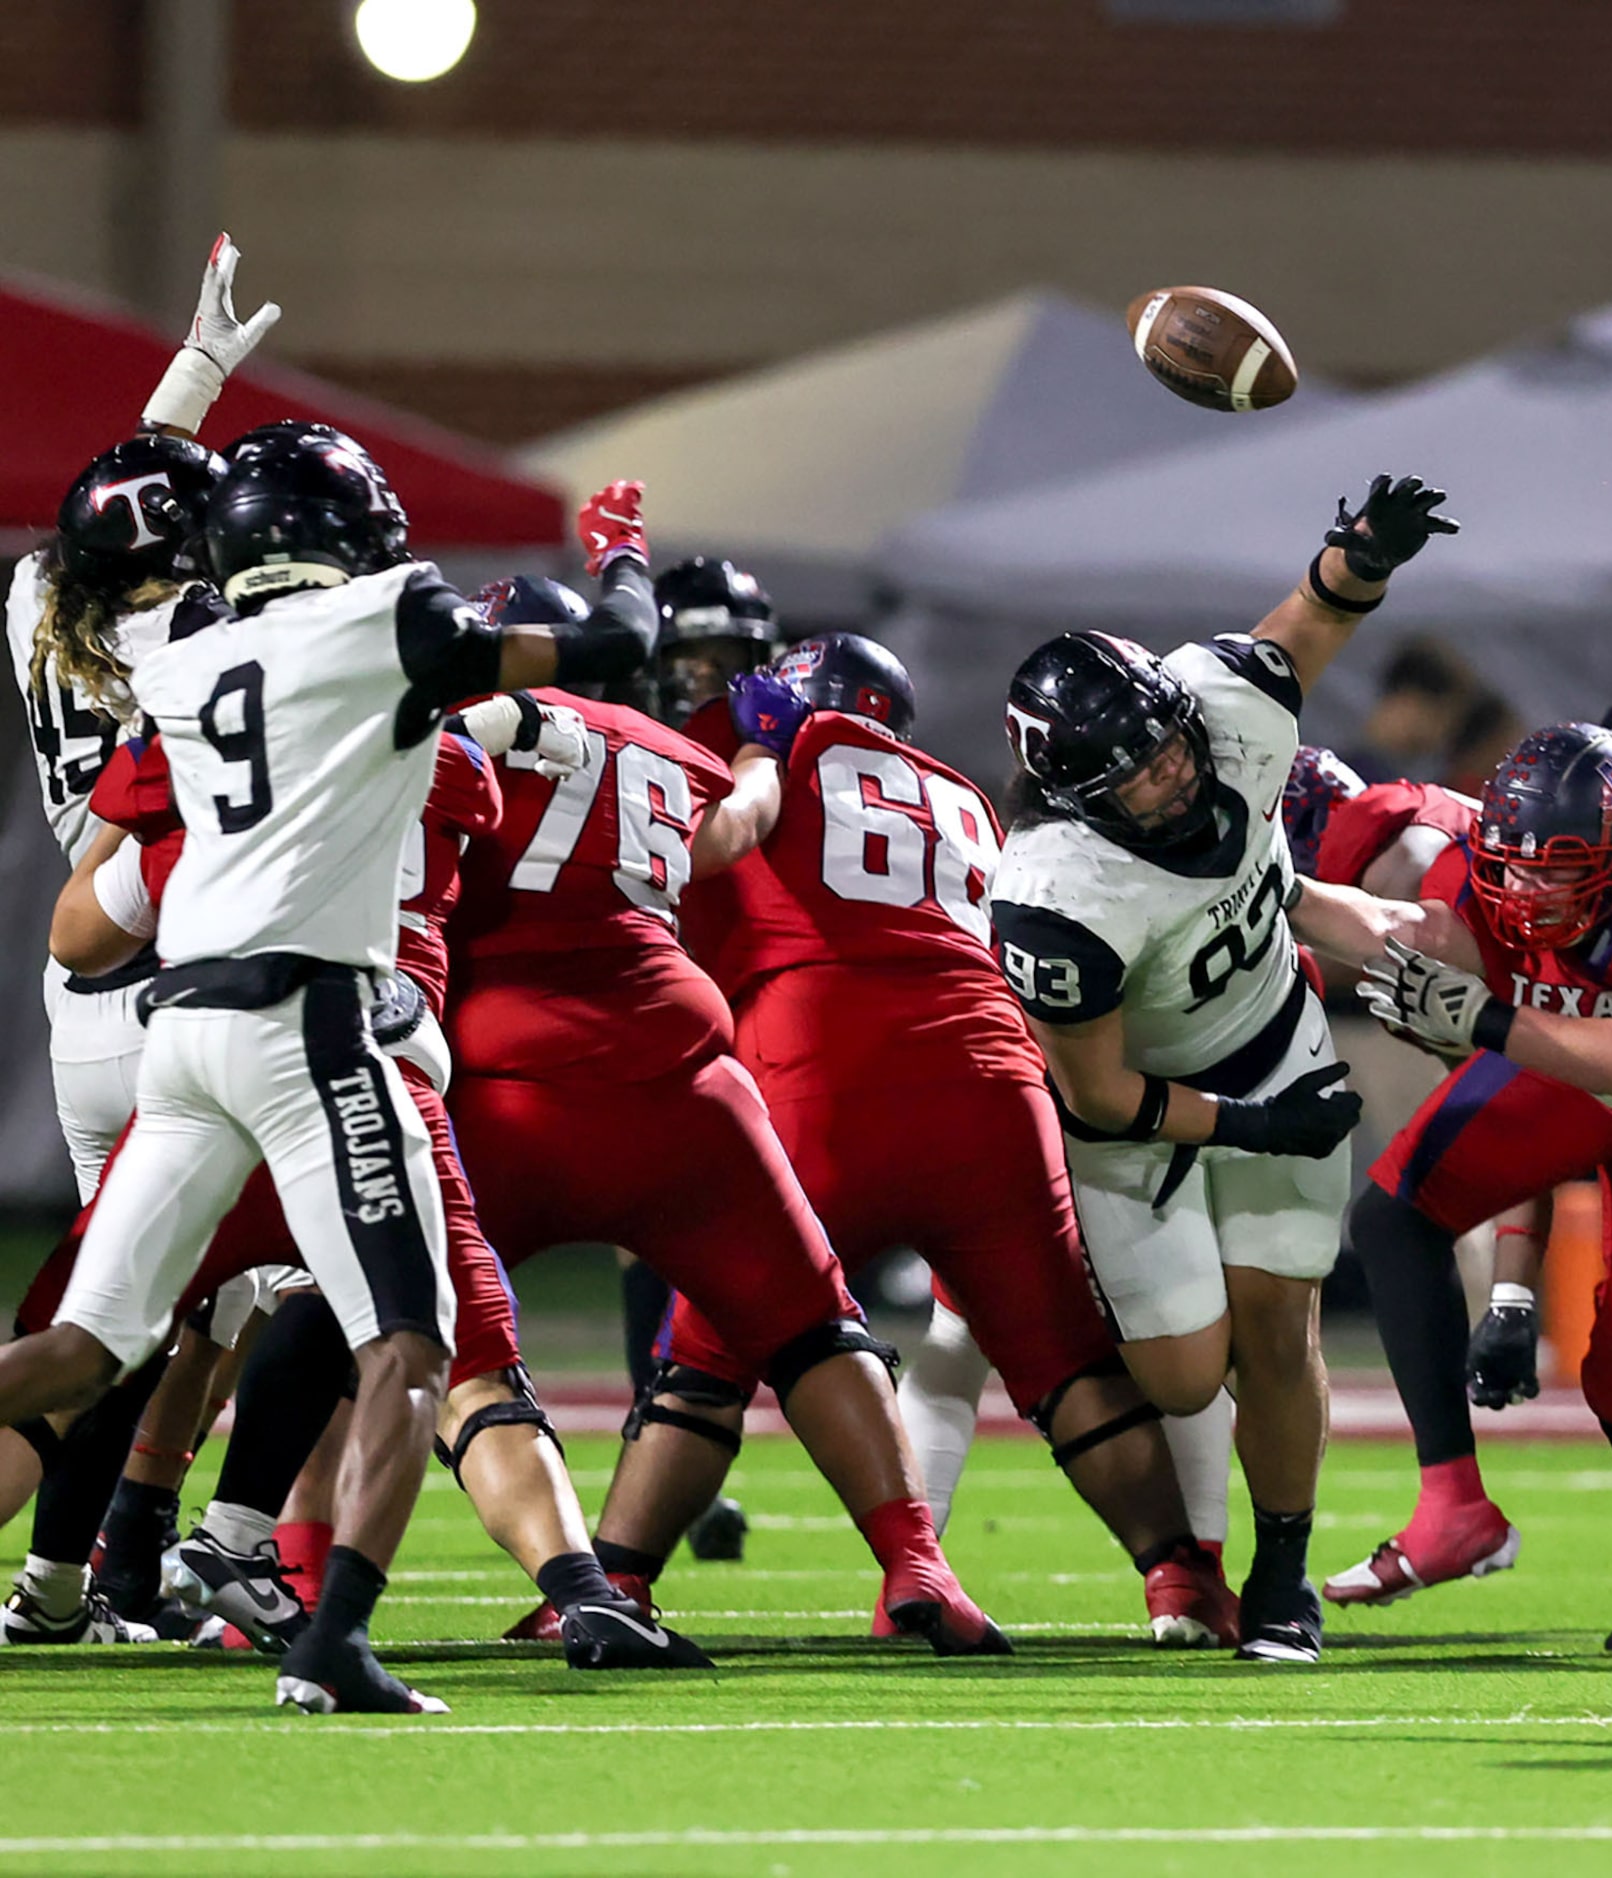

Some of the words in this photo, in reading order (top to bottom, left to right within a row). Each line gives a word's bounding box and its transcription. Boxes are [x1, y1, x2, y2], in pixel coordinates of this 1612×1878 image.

[91, 471, 172, 549] T
[198, 660, 273, 834] 9
[504, 732, 694, 929] 76
[817, 743, 1001, 950] 68
[1003, 941, 1082, 1008] 93
[329, 1066, 405, 1225] TROJANS
